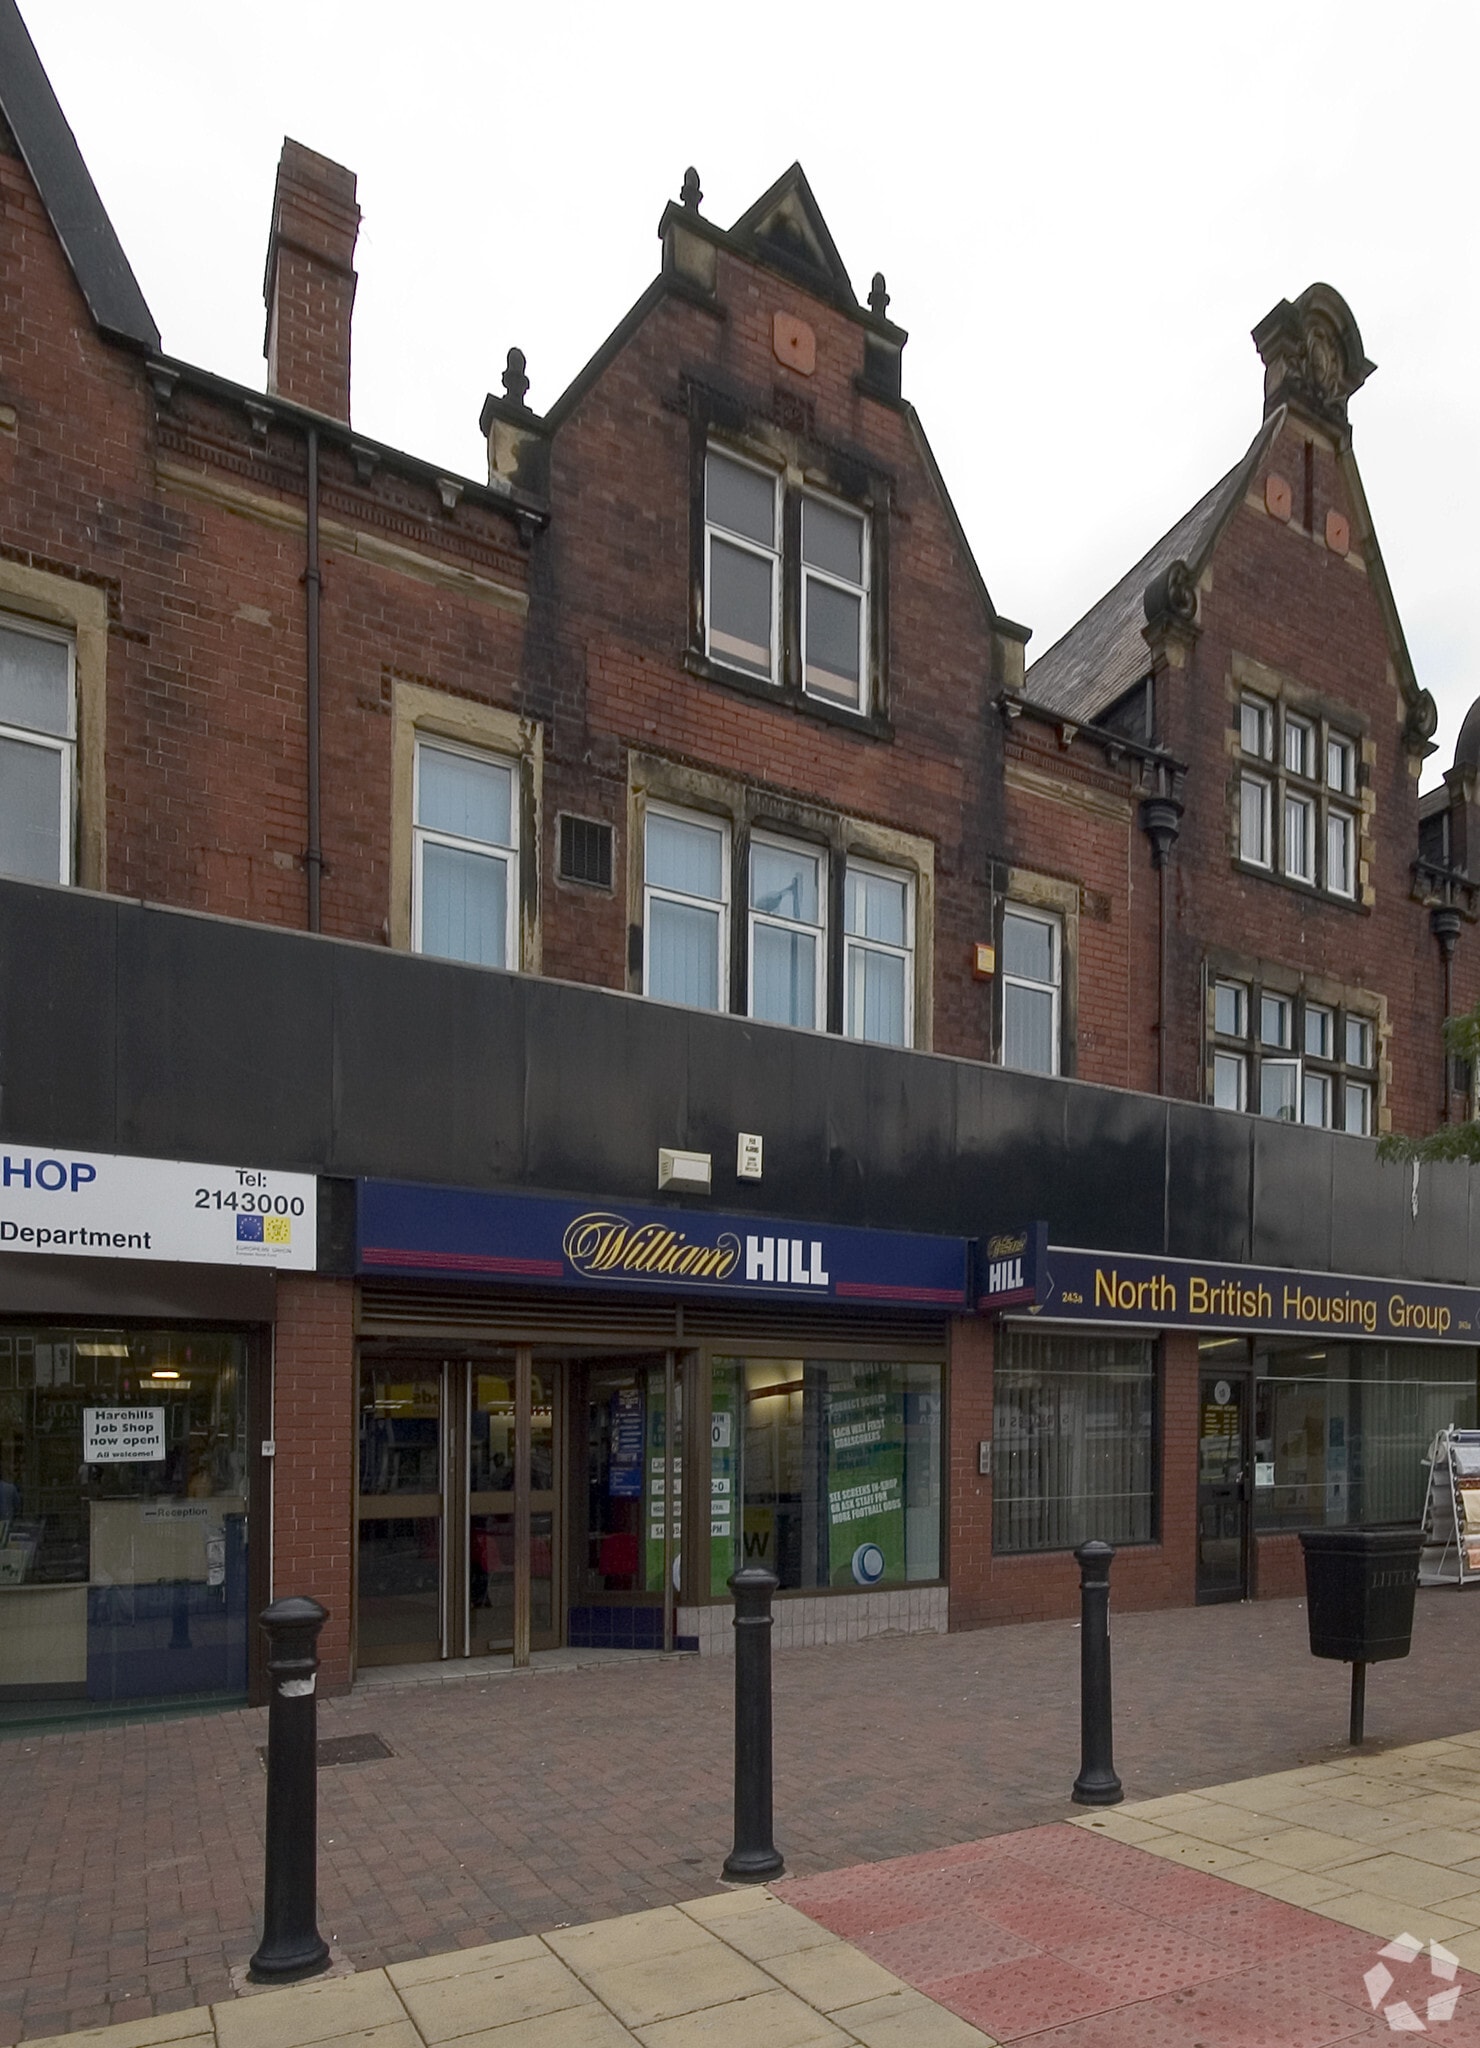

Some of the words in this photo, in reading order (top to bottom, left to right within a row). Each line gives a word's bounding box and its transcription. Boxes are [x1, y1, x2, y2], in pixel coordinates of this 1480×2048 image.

[2, 1156, 97, 1193] HOP
[235, 1170, 267, 1188] Tel:
[194, 1188, 305, 1216] 2143000
[1, 1221, 152, 1250] Department
[563, 1212, 742, 1284] William
[745, 1235, 829, 1286] HILL
[988, 1257, 1024, 1294] HILL
[1094, 1268, 1177, 1312] North
[1188, 1276, 1273, 1319] British
[1283, 1285, 1377, 1332] Housing
[1388, 1294, 1451, 1336] Group
[95, 1422, 118, 1435] Job
[122, 1423, 154, 1434] Shop
[90, 1437, 118, 1446] now
[122, 1435, 160, 1447] open!
[112, 1450, 154, 1458] welcome!
[841, 1484, 871, 1500] SCREENS
[841, 1499, 855, 1511] ASK
[855, 1494, 874, 1507] STAFF
[157, 1507, 209, 1518] Reception
[851, 1503, 883, 1520] FOOTBALL
